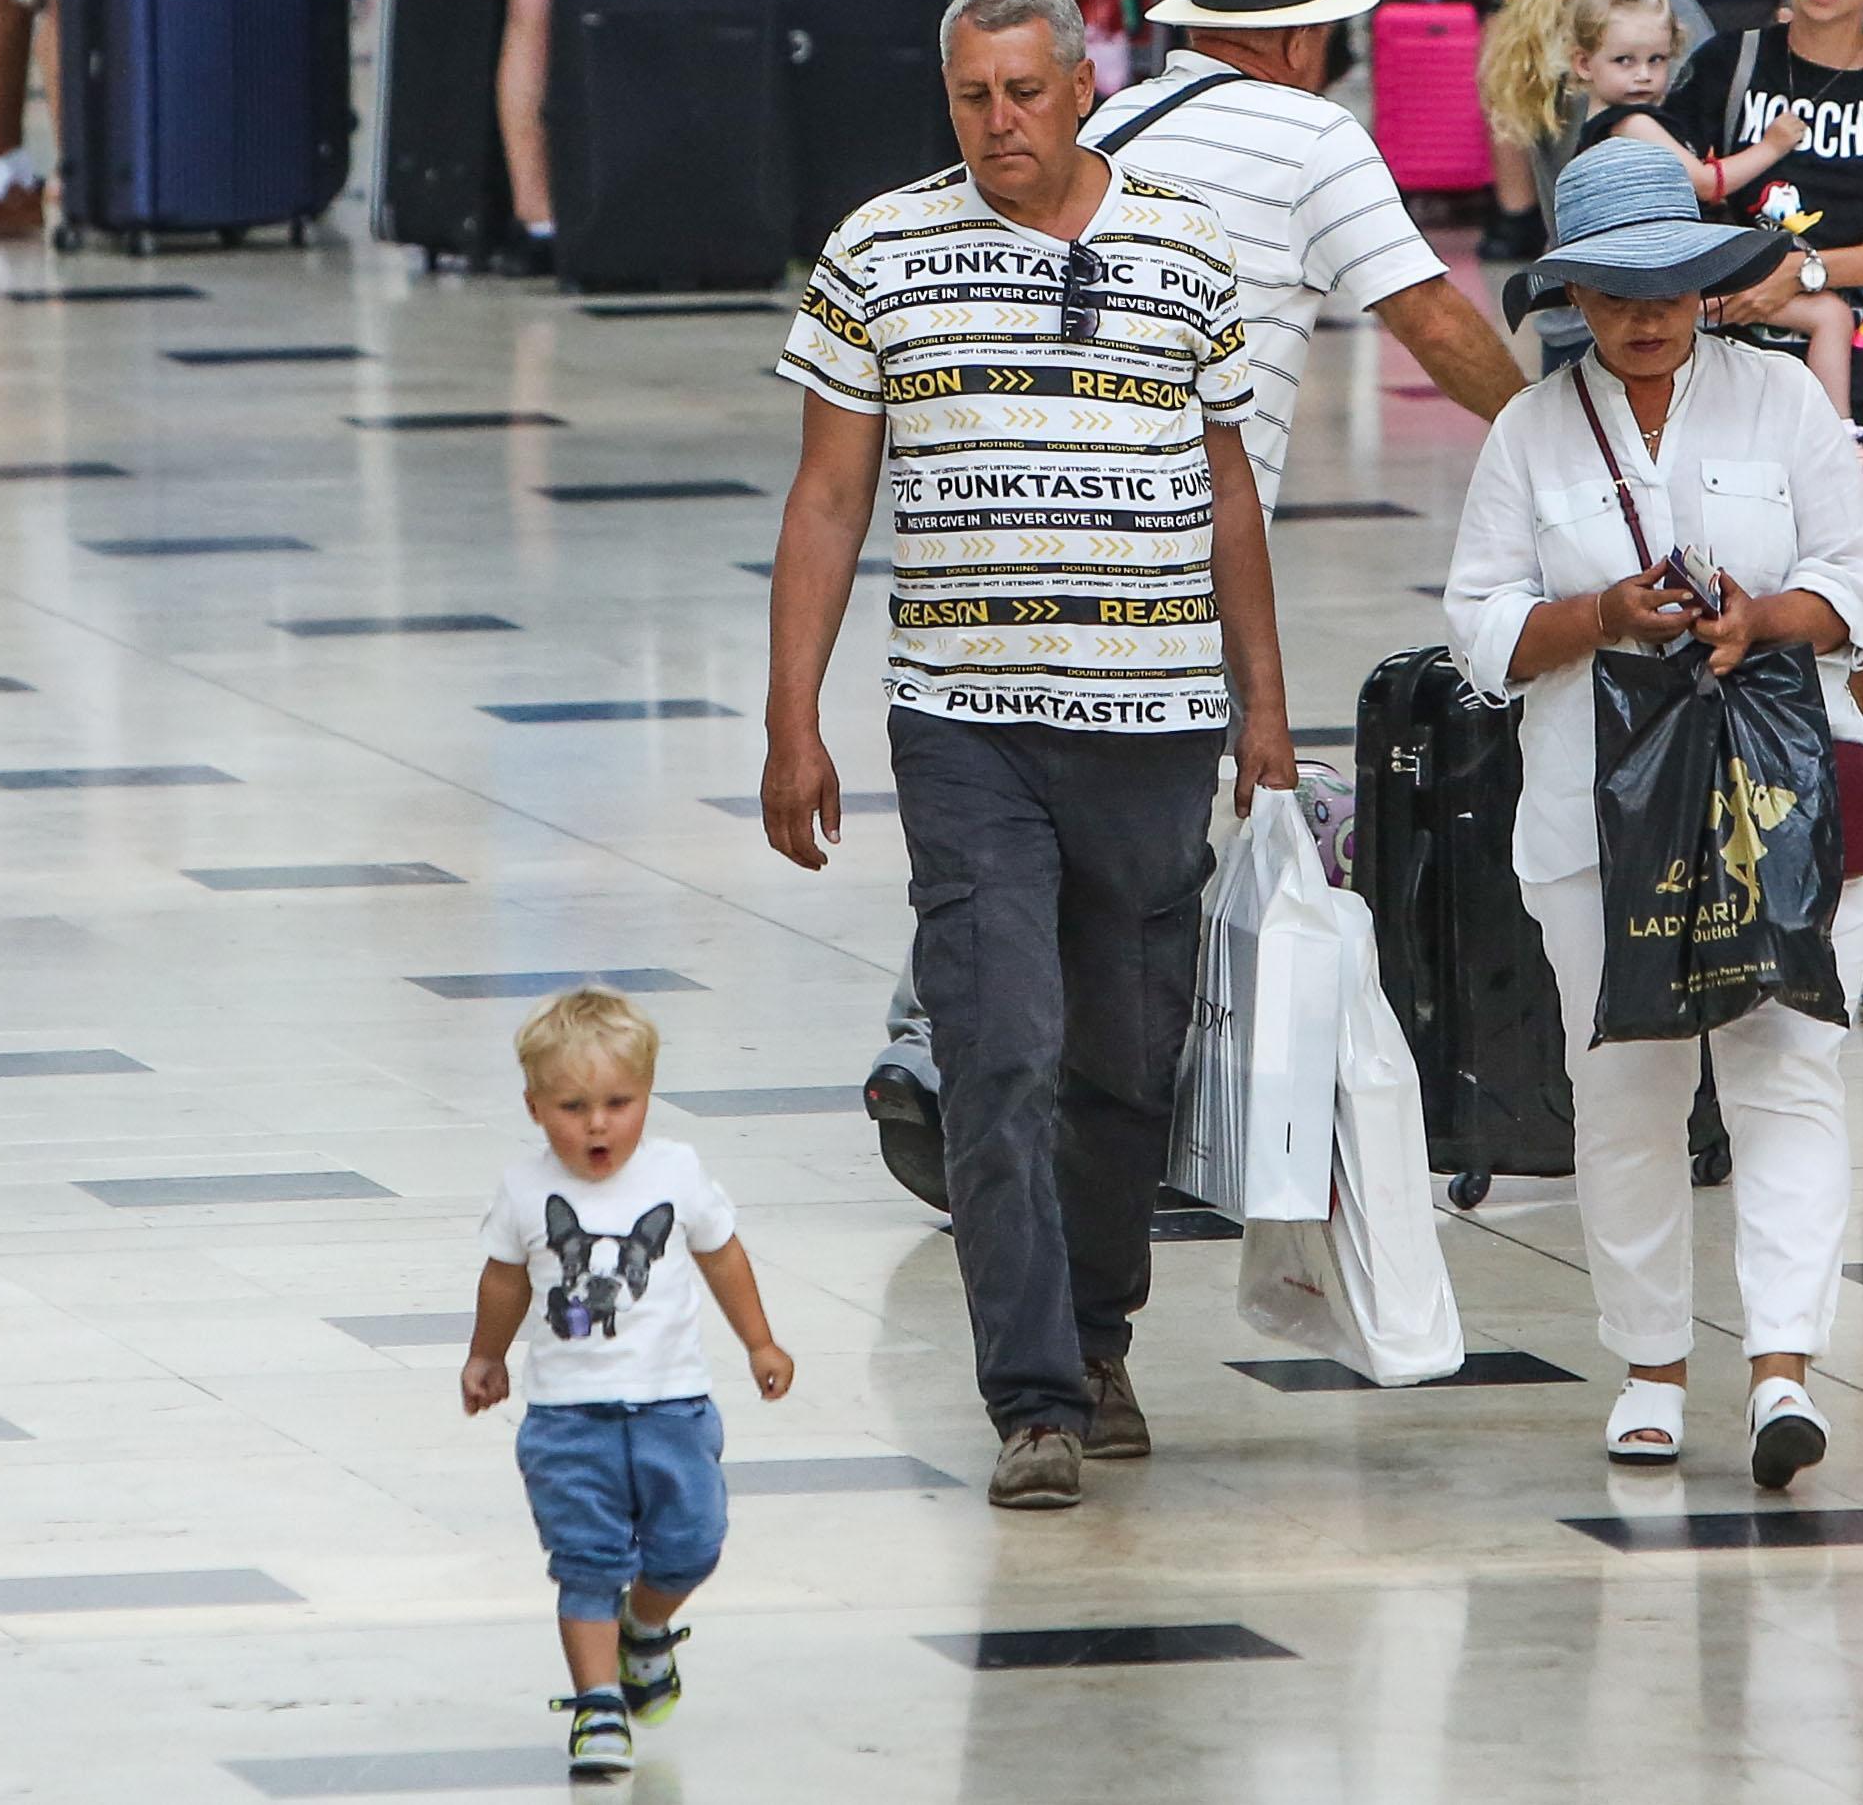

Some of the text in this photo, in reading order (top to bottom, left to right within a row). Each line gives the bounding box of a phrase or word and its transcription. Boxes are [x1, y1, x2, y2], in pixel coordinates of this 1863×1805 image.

[901, 288, 940, 303] GIVE
[942, 287, 958, 299] IN
[969, 286, 1023, 299] NEVER
[1026, 288, 1064, 302] GIVE
[1106, 295, 1157, 314] NEVER
[907, 336, 946, 348] DOUBLE
[947, 334, 961, 342] OR
[966, 334, 1013, 342] NOTHING
[1026, 348, 1043, 356] NOT
[1044, 349, 1086, 357] LISTENING
[828, 378, 869, 400] DOUBLE
[1072, 370, 1190, 408] REASON
[979, 441, 1025, 449] NOTHING
[1047, 442, 1088, 451] DOUBLE
[1090, 443, 1105, 451] OR
[1058, 465, 1101, 473] LISTENING
[937, 474, 1156, 501] PUNKTASTIC
[908, 516, 937, 529] NEVER
[939, 515, 966, 527] GIVE
[967, 514, 981, 525] IN
[990, 512, 1047, 525] NEVER
[1050, 513, 1092, 525] GIVE
[1094, 514, 1113, 526] IN
[1134, 515, 1175, 528] NEVER
[1176, 513, 1198, 527] GIVE
[990, 565, 1039, 573] NOTHING
[1061, 564, 1104, 572] DOUBLE
[1107, 566, 1122, 574] OR
[1100, 598, 1208, 624] REASON
[1001, 665, 1048, 673] NOTHING
[1067, 669, 1107, 677] DOUBLE
[1125, 670, 1167, 678] NOTHING
[1074, 690, 1115, 698] LISTENING
[946, 690, 1166, 724] PUNKTASTIC
[1692, 923, 1739, 944] Outlet
